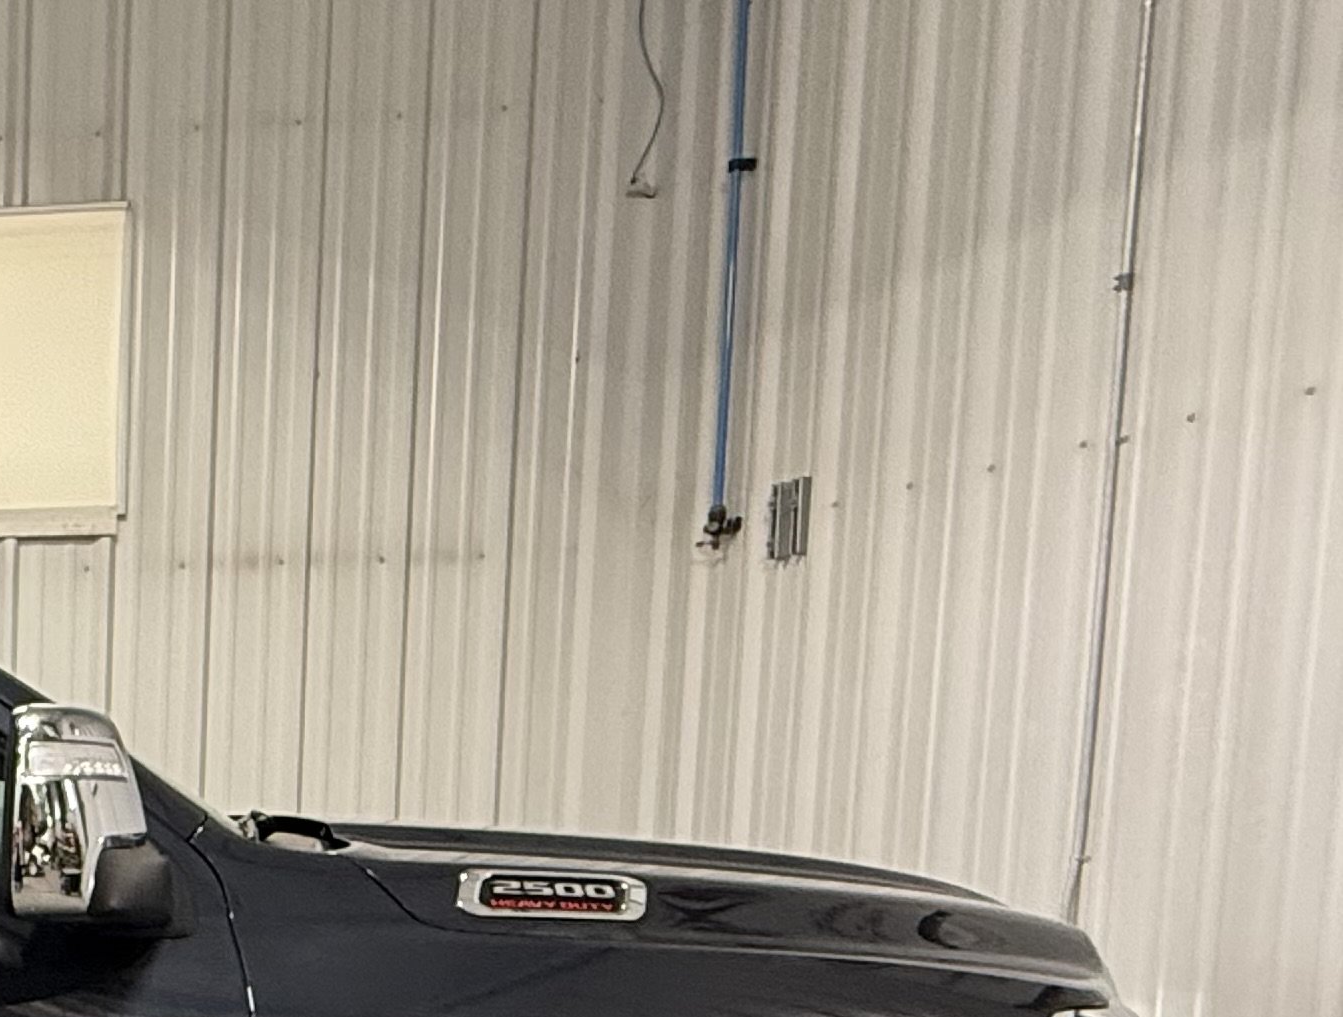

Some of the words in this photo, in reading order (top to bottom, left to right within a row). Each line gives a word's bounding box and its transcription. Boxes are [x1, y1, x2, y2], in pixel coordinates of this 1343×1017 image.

[491, 879, 615, 899] 2500
[490, 898, 556, 909] HEAVY
[559, 901, 613, 911] DUTY
